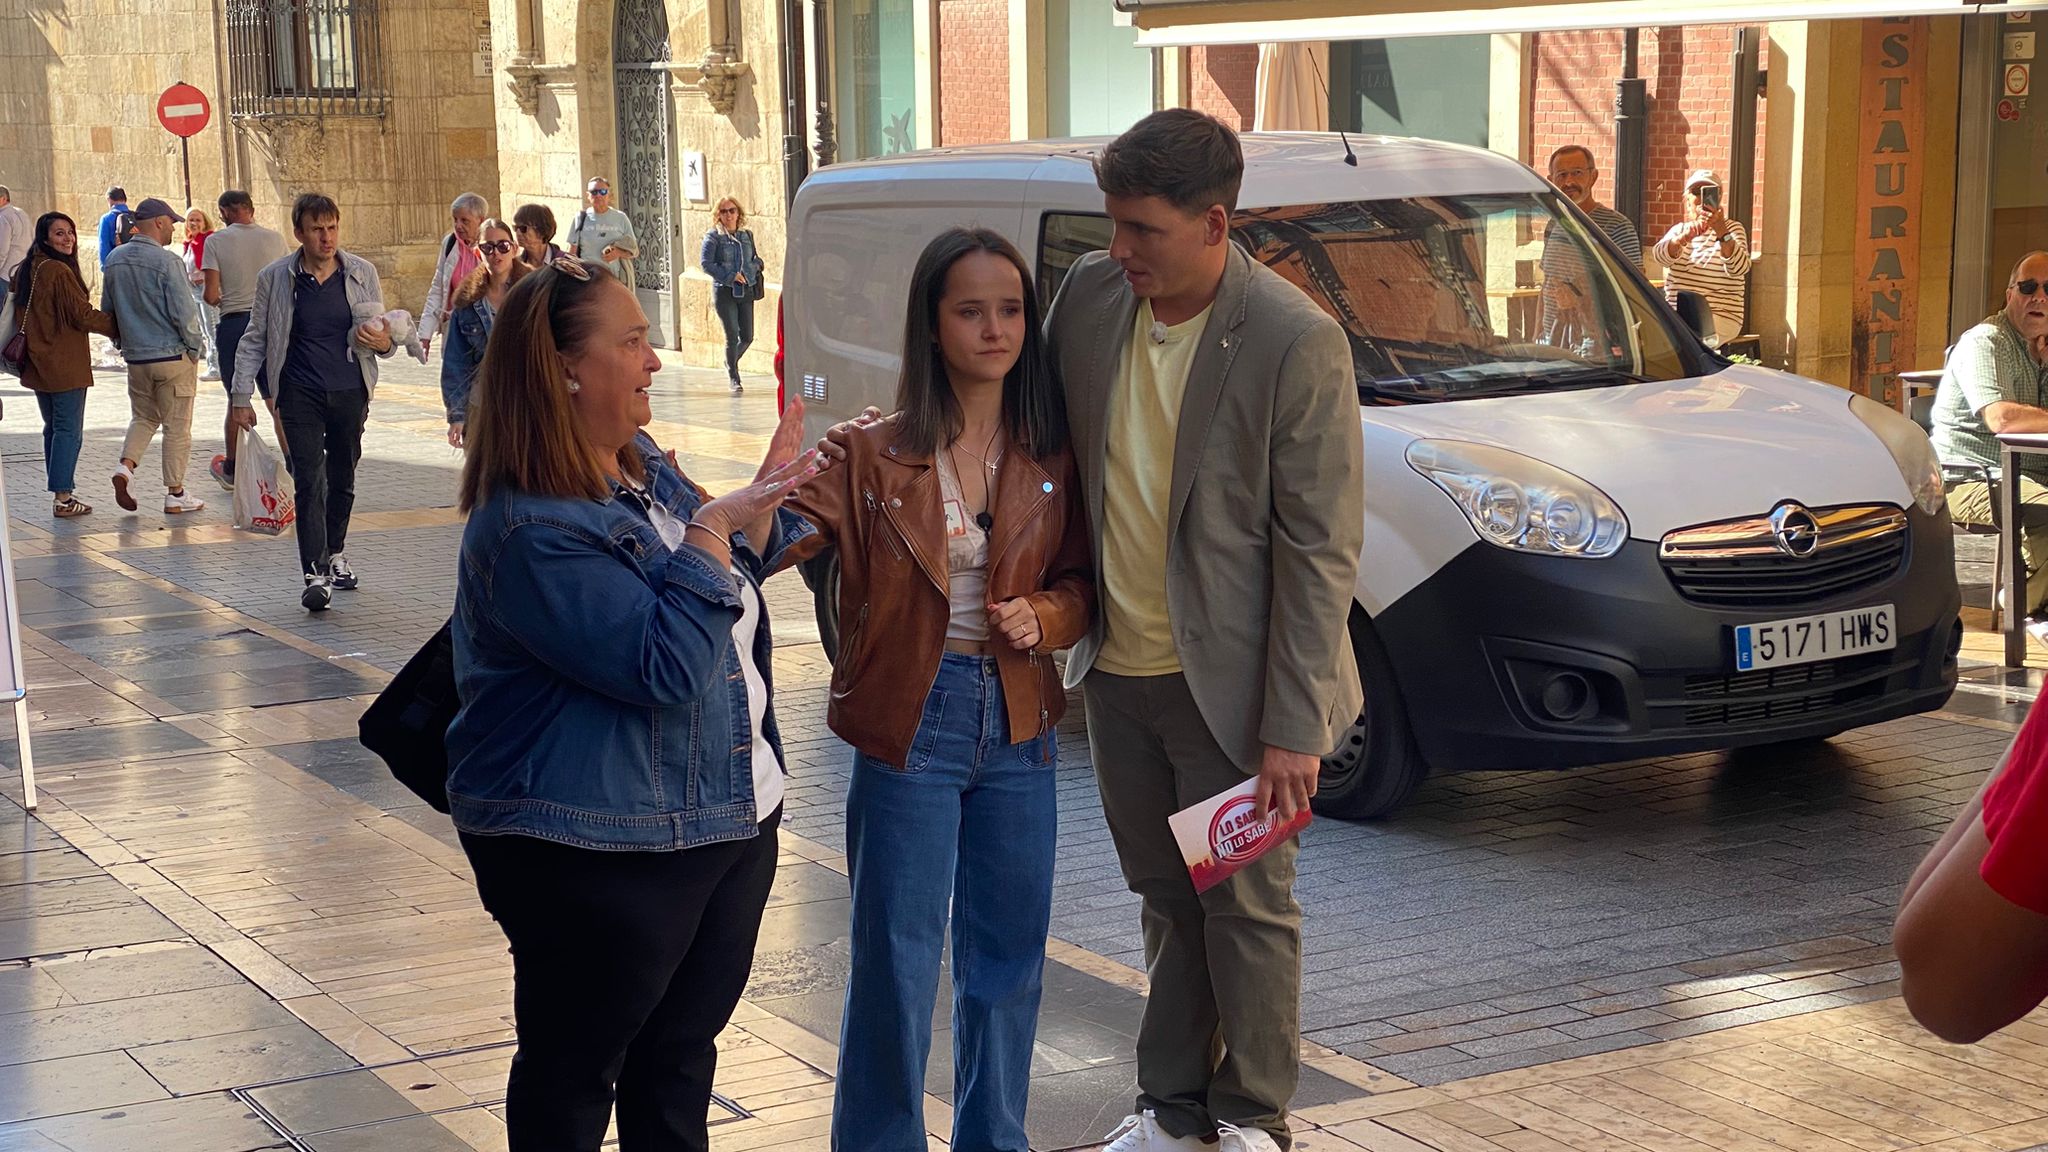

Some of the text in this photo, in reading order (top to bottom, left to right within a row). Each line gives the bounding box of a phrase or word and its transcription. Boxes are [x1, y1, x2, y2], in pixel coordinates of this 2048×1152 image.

[1759, 611, 1889, 661] 5171 HWS
[1742, 652, 1749, 662] E
[1219, 807, 1257, 837] LO SAB
[1215, 840, 1235, 860] NO
[1233, 835, 1246, 849] LO
